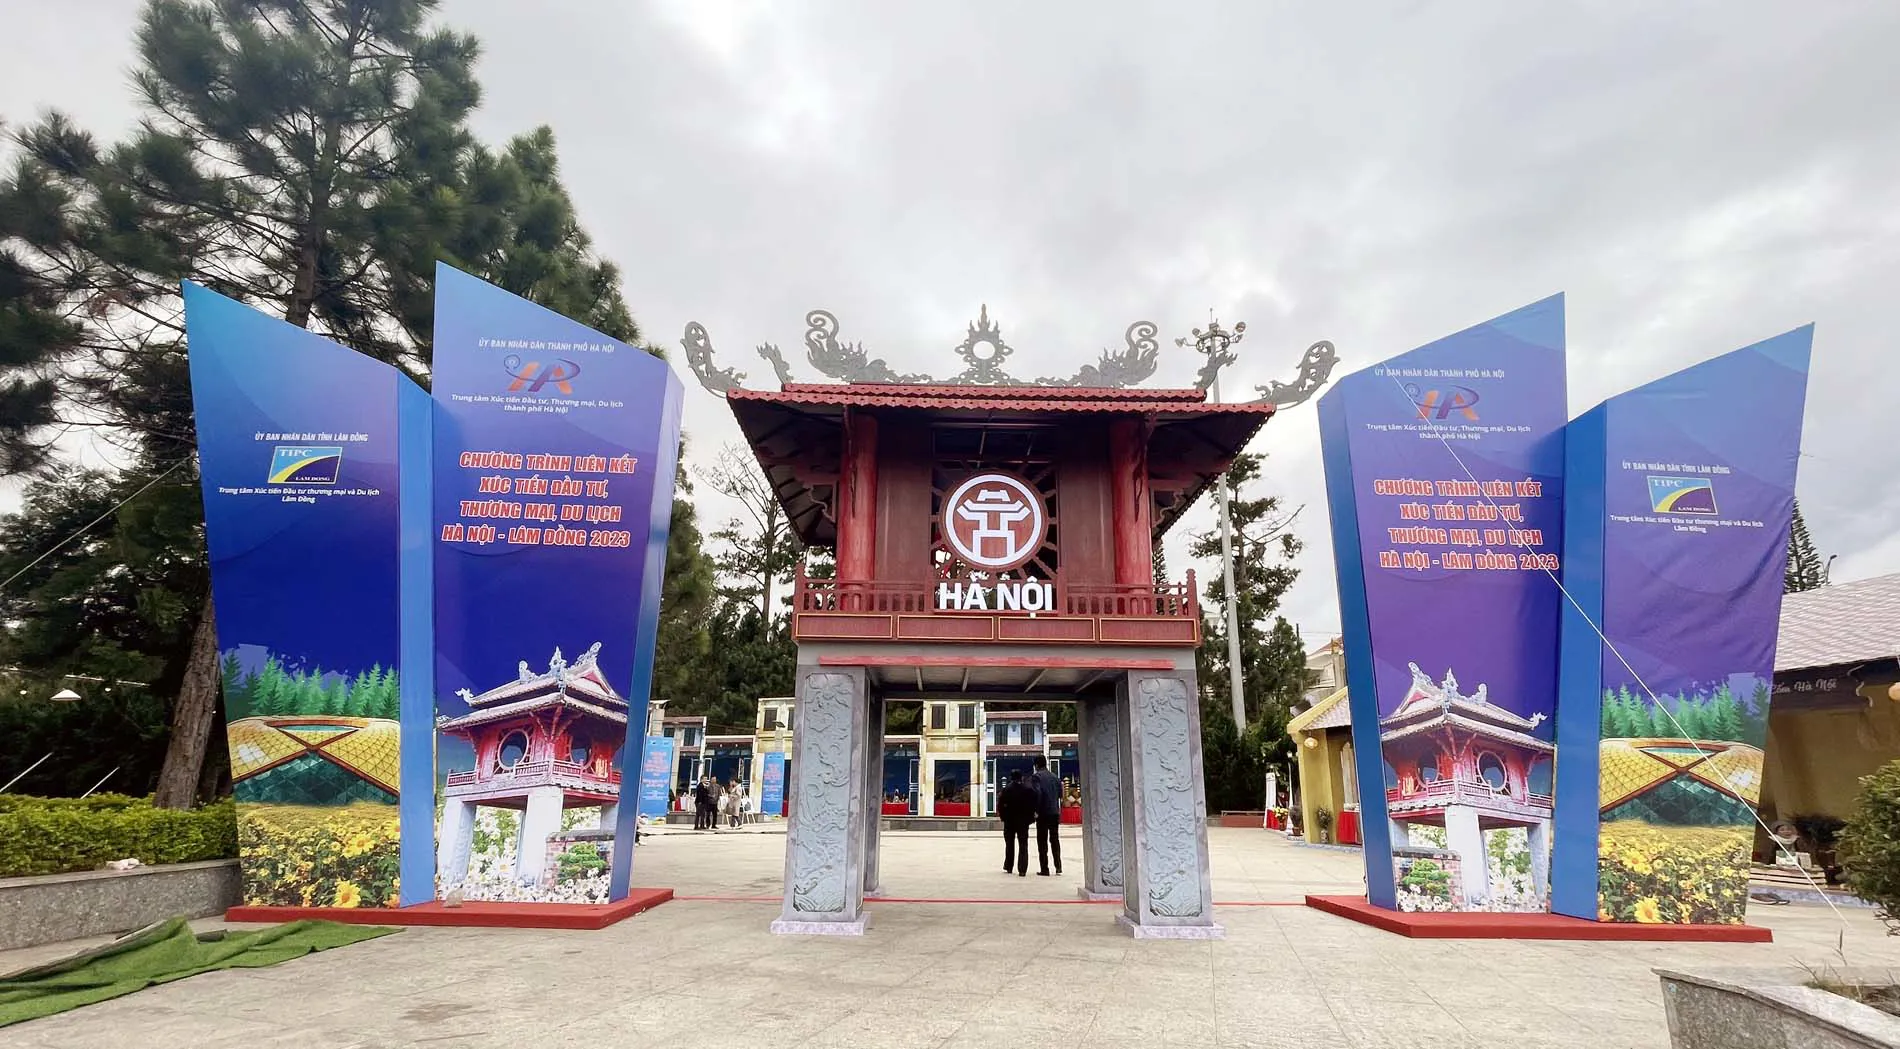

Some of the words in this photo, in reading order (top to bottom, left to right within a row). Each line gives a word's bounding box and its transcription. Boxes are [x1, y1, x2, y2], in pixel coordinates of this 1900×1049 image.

[479, 337, 488, 347] ỦY
[491, 340, 505, 348] BAN
[508, 340, 528, 348] NHÂN
[531, 341, 544, 349] DÂN
[548, 341, 571, 350] THÀNH
[574, 342, 587, 351] PHỐ
[602, 344, 614, 353] NỘI
[1375, 368, 1383, 376] ỦY
[1424, 369, 1438, 377] DÂN
[1440, 369, 1463, 377] THÀNH
[1465, 368, 1479, 377] PHỐ
[1481, 369, 1491, 377] HÀ
[1493, 370, 1504, 379] NỘI
[452, 394, 472, 402] Trung
[551, 398, 579, 407] Thương
[581, 400, 596, 408] mại,
[610, 400, 623, 408] lịch
[556, 406, 568, 414] Nội
[255, 431, 264, 440] ỦY
[281, 433, 300, 441] NHÂN
[318, 432, 332, 440] TỈNH
[334, 433, 349, 441] LÂM
[350, 432, 368, 441] ĐỒNG
[460, 451, 521, 469] CHƯƠNG
[527, 452, 570, 471] TRÌNH
[574, 454, 605, 472] LIÊN
[609, 454, 637, 473] KẾT
[479, 475, 510, 493] XÚC
[515, 475, 547, 494] TIẾN
[551, 476, 582, 496] ĐẦU
[587, 480, 608, 499] TƯ,
[1374, 478, 1432, 496] CHƯƠNG
[1436, 479, 1480, 496] TRÌNH
[1483, 479, 1513, 496] LIÊN
[1516, 478, 1541, 496] KẾT
[460, 500, 520, 518] THƯƠNG
[524, 504, 557, 523] MẠI,
[561, 506, 582, 520] DU
[586, 506, 621, 523] LỊCH
[1401, 503, 1429, 520] XÚC
[1432, 501, 1464, 520] TIẾN
[1467, 501, 1497, 520] ĐẦU
[1500, 506, 1524, 522] TƯ,
[442, 521, 463, 541] HÀ
[467, 524, 495, 545] NỘI
[508, 525, 539, 544] LÂM
[544, 524, 586, 546] ĐỒNG
[590, 531, 630, 547] 2023
[1389, 527, 1447, 544] THƯƠNG
[1450, 529, 1481, 546] MẠI,
[1485, 530, 1505, 544] DU
[1509, 530, 1543, 547] LỊCH
[1380, 547, 1400, 567] HÀ
[1404, 550, 1429, 570] NỘI
[1442, 551, 1473, 569] LÂM
[1476, 549, 1516, 569] ĐỒNG
[1519, 555, 1559, 570] 2023
[940, 575, 987, 610] HÀ
[997, 576, 1052, 618] NỘI
